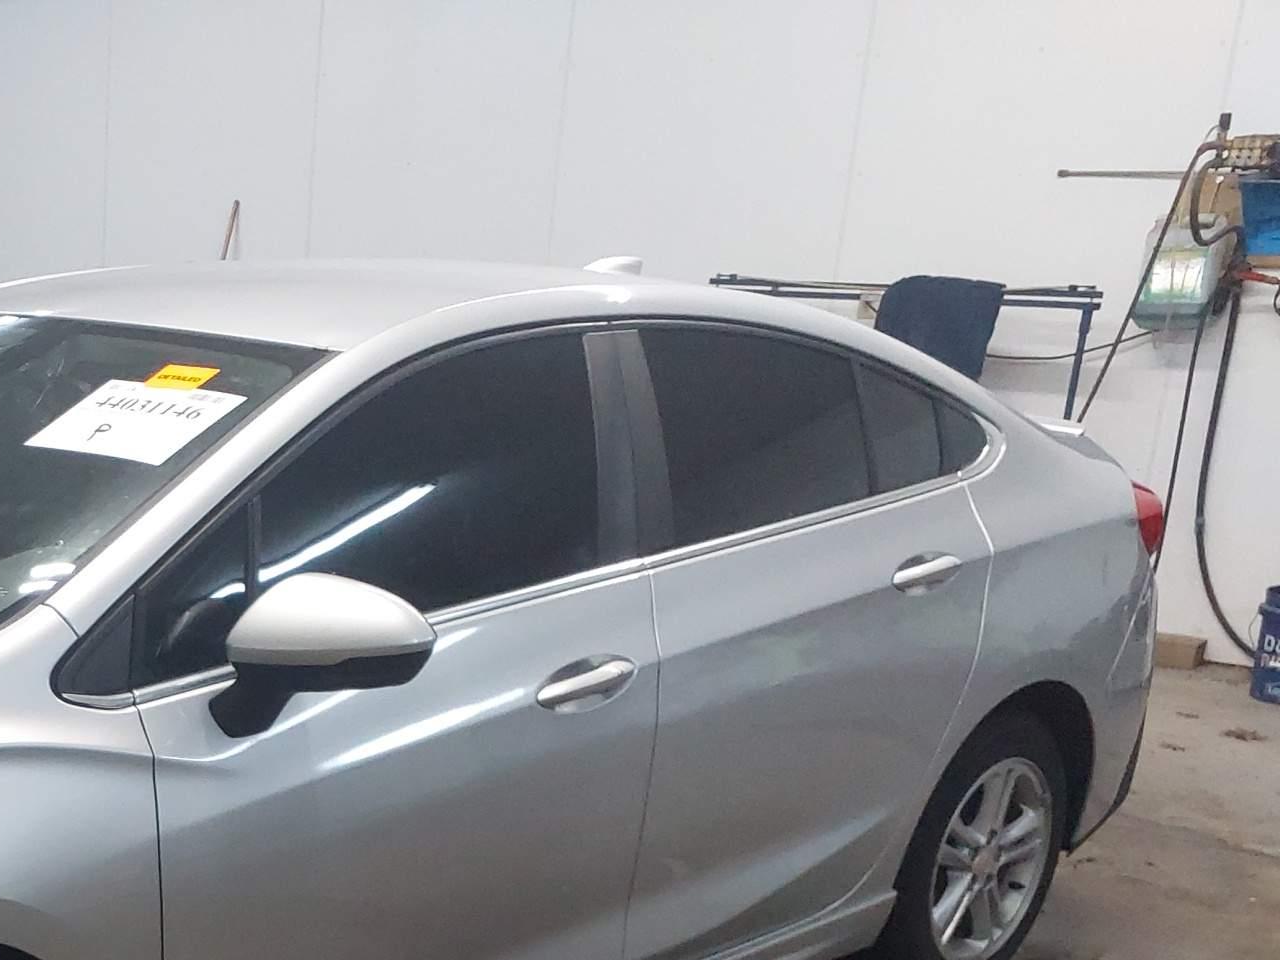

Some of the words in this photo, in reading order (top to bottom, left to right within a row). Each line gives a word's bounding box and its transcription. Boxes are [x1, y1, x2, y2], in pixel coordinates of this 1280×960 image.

[157, 374, 202, 383] DETAILED
[96, 396, 202, 419] 44031146
[87, 423, 111, 441] P
